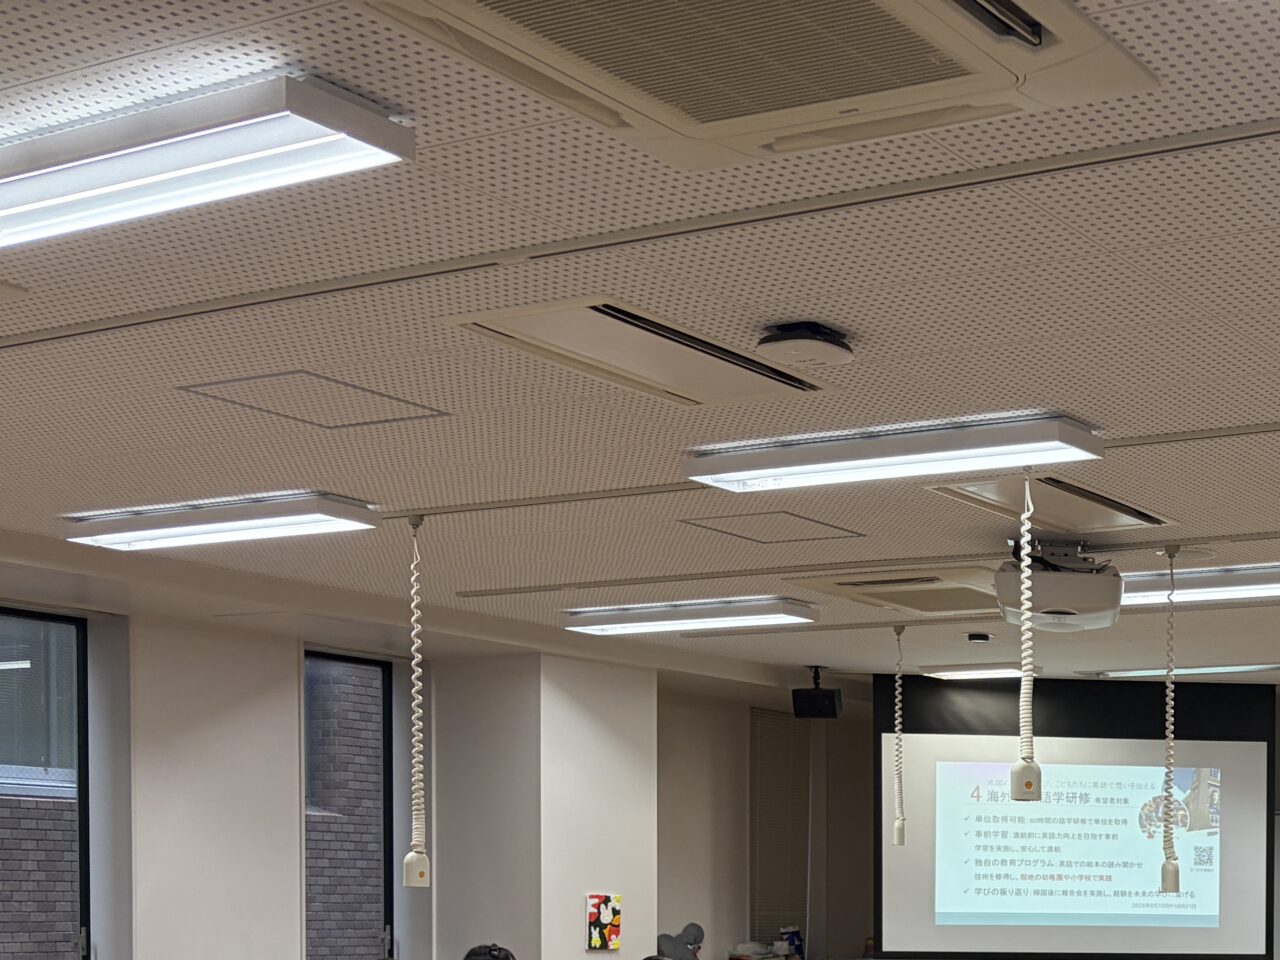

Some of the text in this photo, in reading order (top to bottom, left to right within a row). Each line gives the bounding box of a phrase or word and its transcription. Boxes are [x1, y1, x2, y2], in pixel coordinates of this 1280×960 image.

[970, 785, 981, 802] 4
[987, 789, 1091, 804] 海外語学研修
